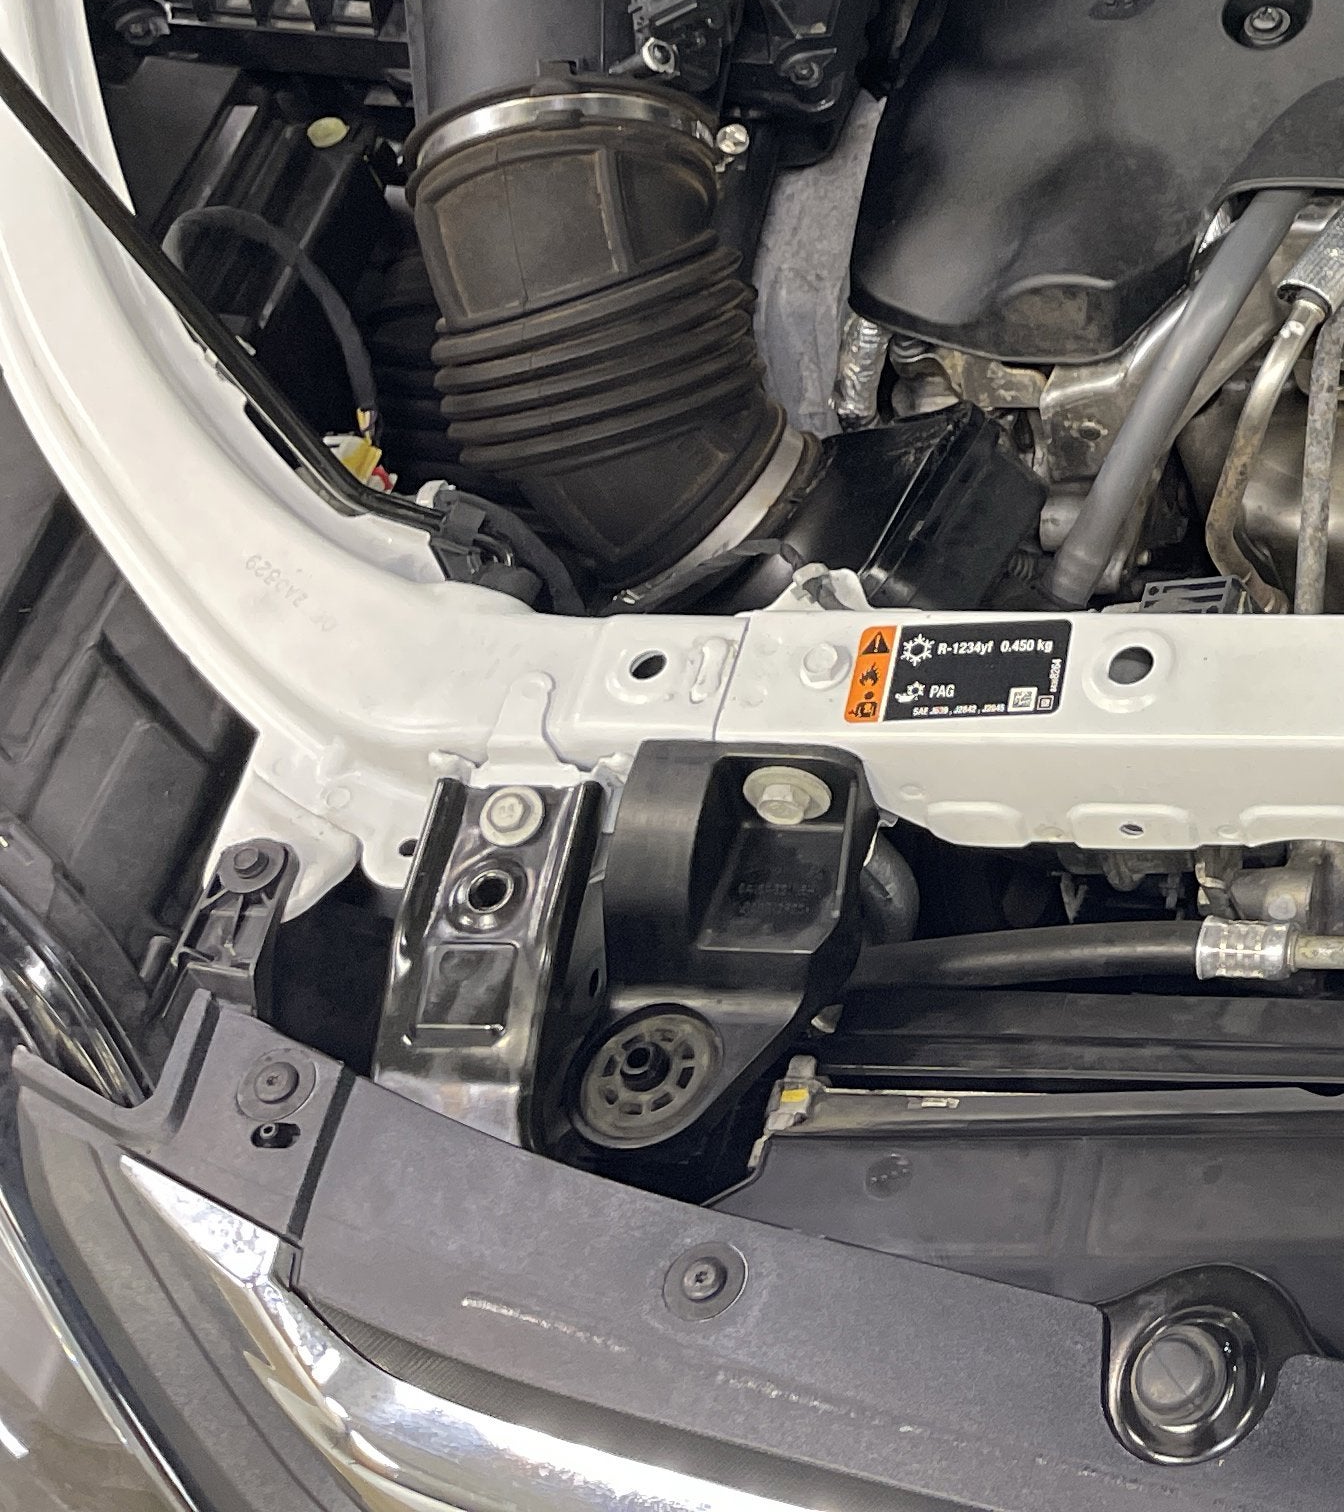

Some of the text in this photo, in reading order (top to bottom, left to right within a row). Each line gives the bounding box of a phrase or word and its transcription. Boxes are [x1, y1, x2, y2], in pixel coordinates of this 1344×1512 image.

[937, 639, 1053, 656] R-1234yf 0.450 kg
[929, 684, 955, 699] PAG
[912, 706, 929, 717] SAE
